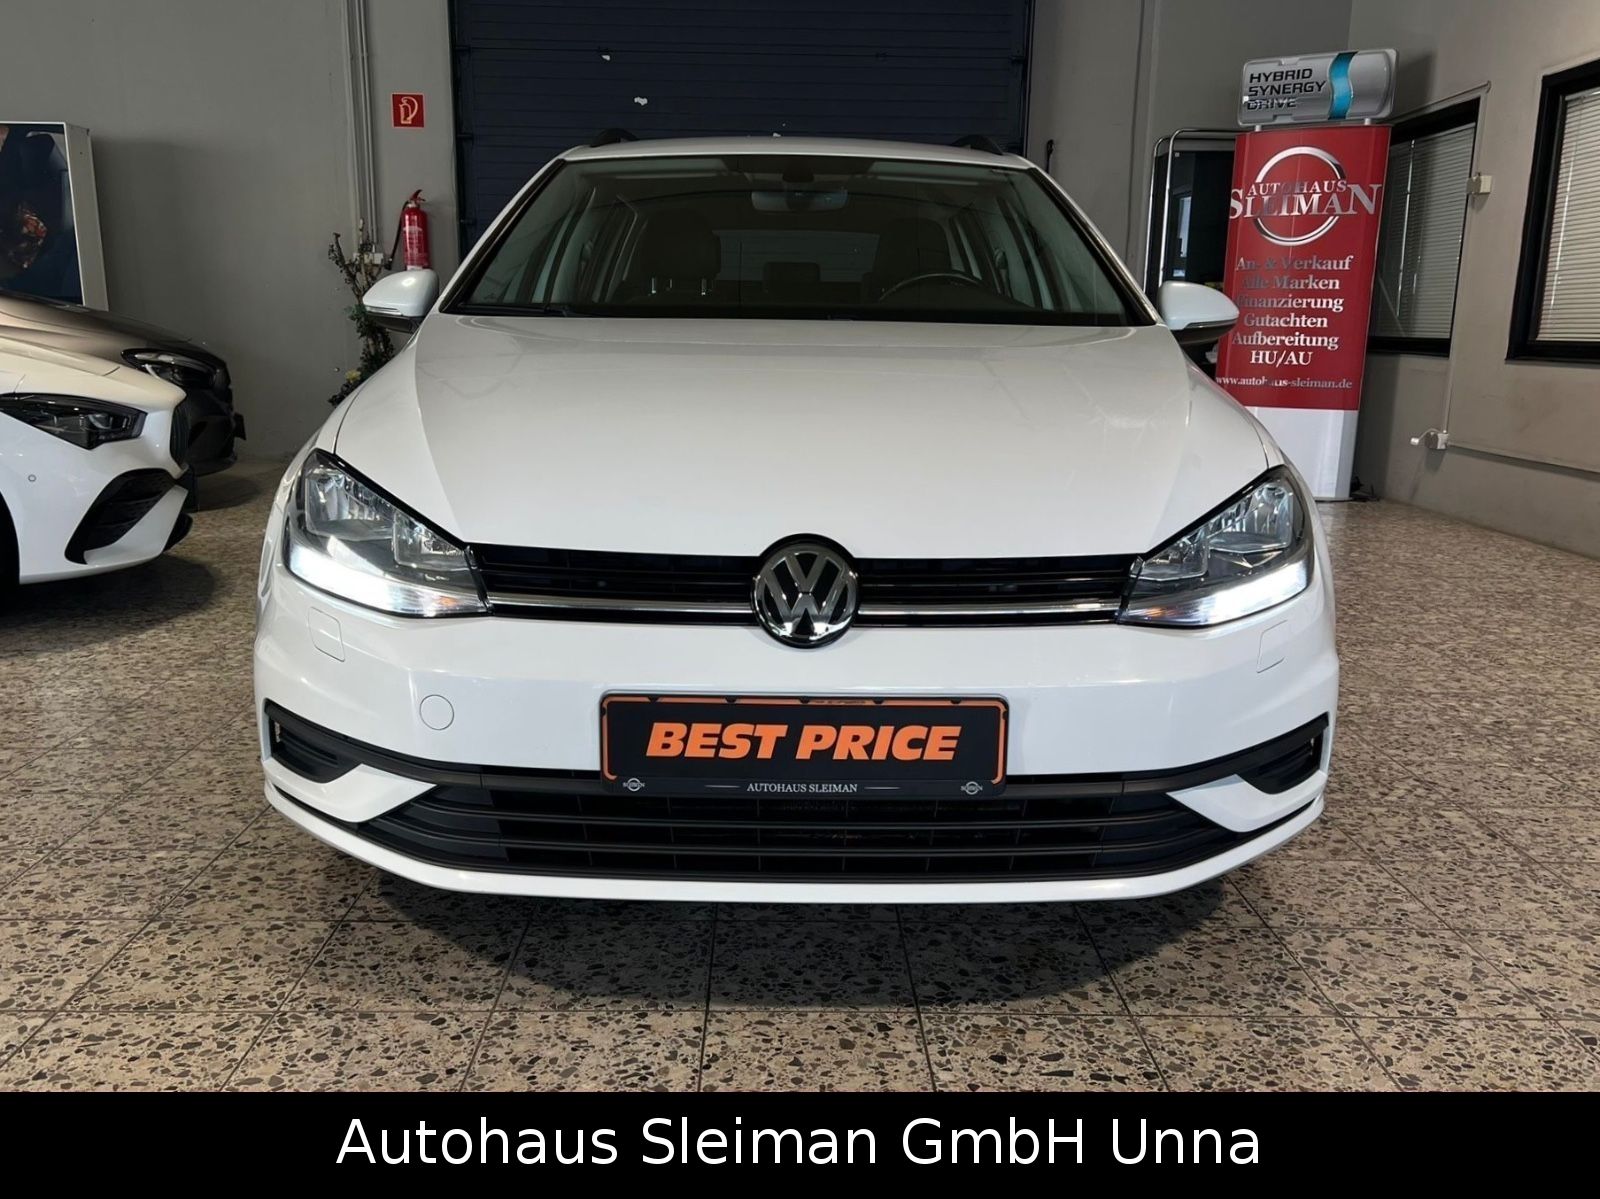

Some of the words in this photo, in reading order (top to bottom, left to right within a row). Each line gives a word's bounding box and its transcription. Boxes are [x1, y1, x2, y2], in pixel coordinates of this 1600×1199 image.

[1249, 68, 1313, 83] HYBRID
[1248, 80, 1327, 97] SYNERGY
[1246, 97, 1297, 110] DRIVE
[1247, 179, 1347, 196] AUTOHAUS
[1229, 183, 1382, 220] SLEIMAN
[1281, 255, 1354, 271] Verkauf
[1273, 274, 1340, 290] Marken
[1243, 312, 1328, 329] Gutachten
[1232, 331, 1339, 350] Aufbereitung
[1250, 350, 1313, 368] HU/AU
[1216, 375, 1353, 390] www.autohus-sleiman.de
[646, 722, 788, 758] BEST
[795, 725, 961, 760] PRICE
[747, 783, 807, 793] AUTOHAUS
[808, 784, 858, 793] SLEIMAN
